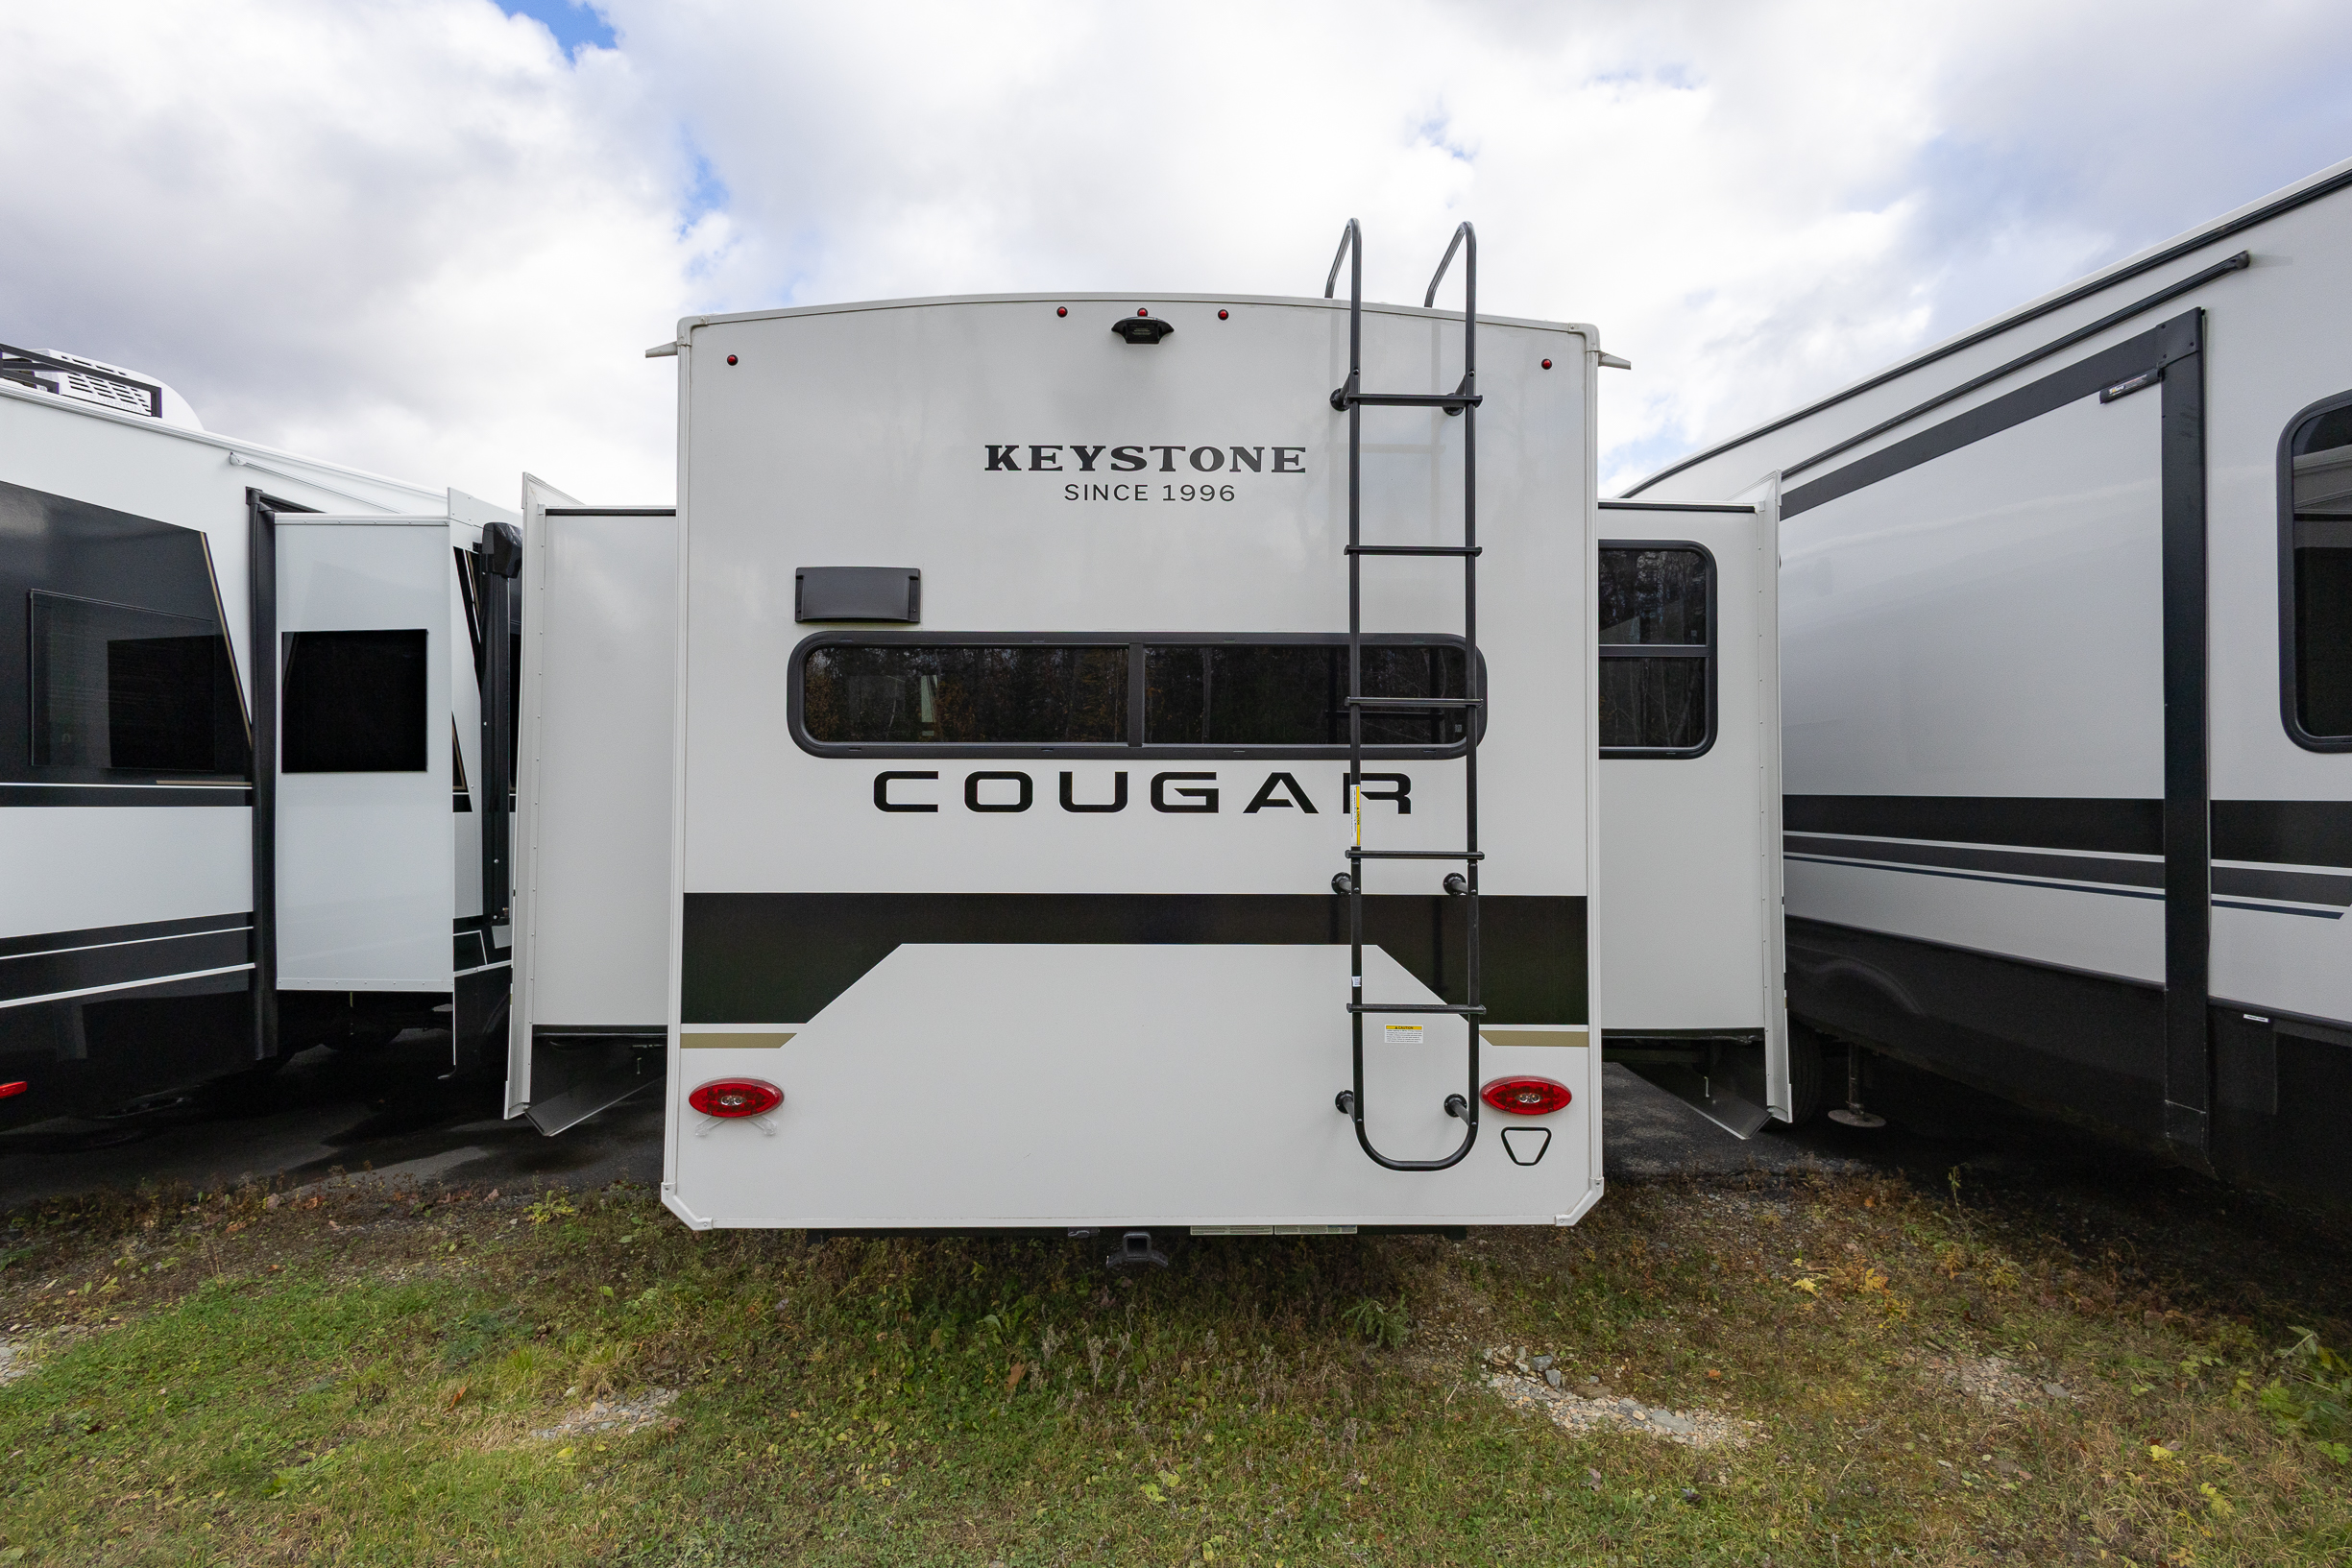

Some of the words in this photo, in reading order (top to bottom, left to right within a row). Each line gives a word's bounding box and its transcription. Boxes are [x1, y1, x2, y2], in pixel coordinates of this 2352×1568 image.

[89, 395, 142, 413] FURRION
[984, 445, 1306, 472] KEYSTONE
[1064, 484, 1149, 501] SINCE
[1162, 484, 1235, 501] 1996
[873, 771, 1412, 814] COUGAR
